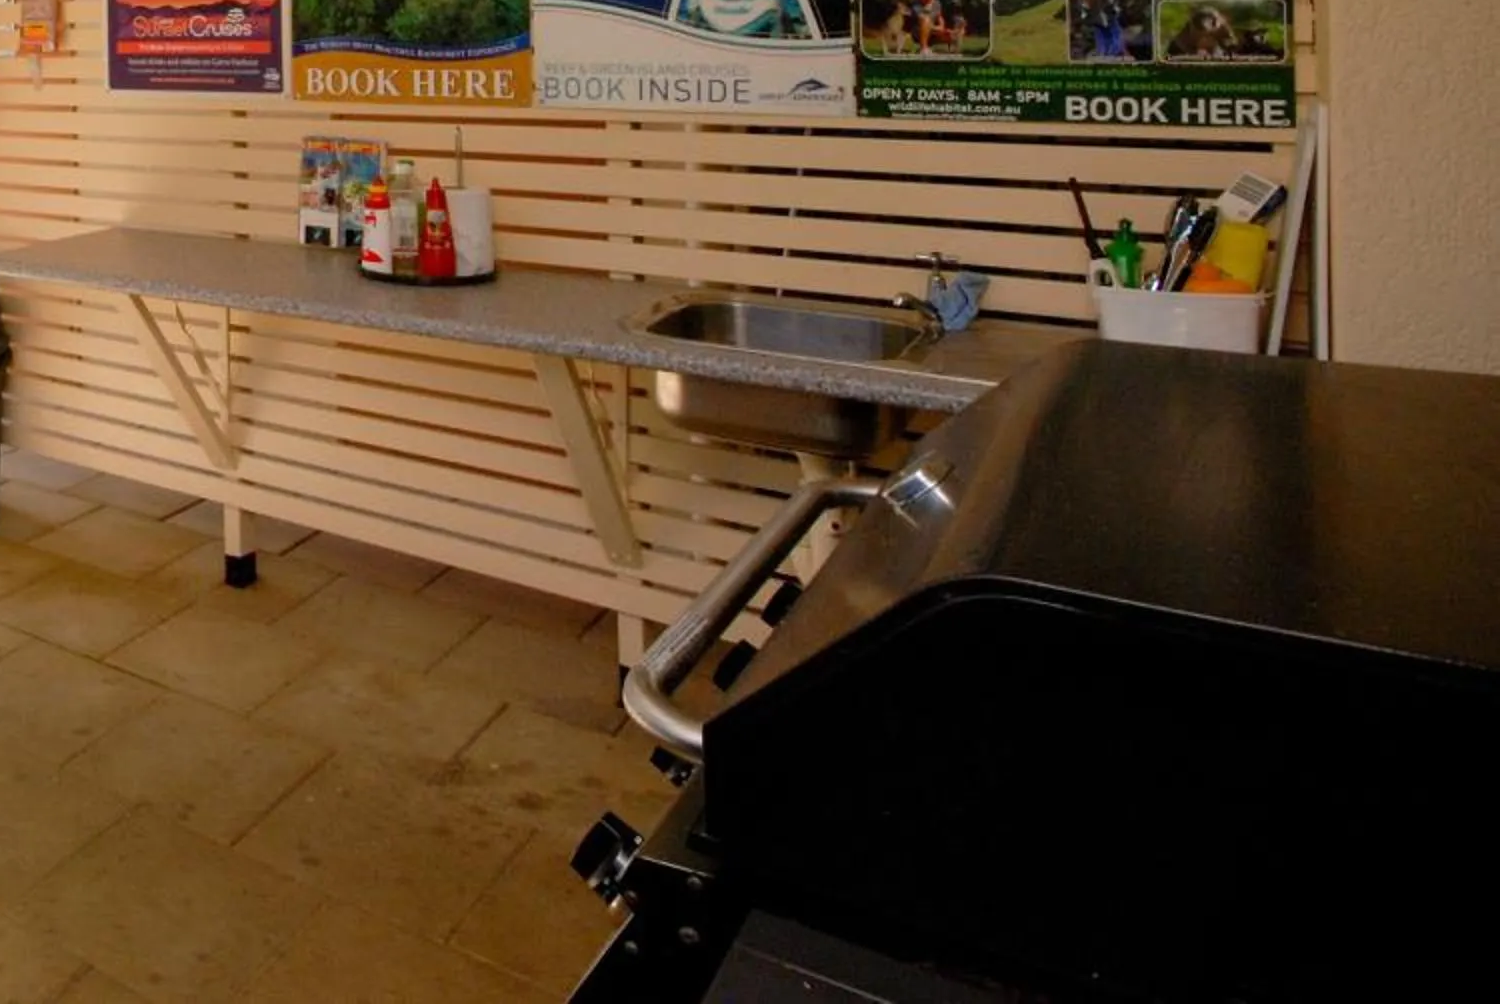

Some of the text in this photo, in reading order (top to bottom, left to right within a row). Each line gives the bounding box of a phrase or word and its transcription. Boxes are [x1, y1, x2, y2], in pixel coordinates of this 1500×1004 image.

[133, 14, 253, 38] Sunset Cruises
[306, 67, 399, 97] BOOK
[412, 68, 514, 100] HERE
[544, 76, 752, 104] BOOK INSIDE
[863, 87, 902, 100] OPEN
[905, 88, 916, 101] 7
[1065, 95, 1289, 127] BOOK HERE
